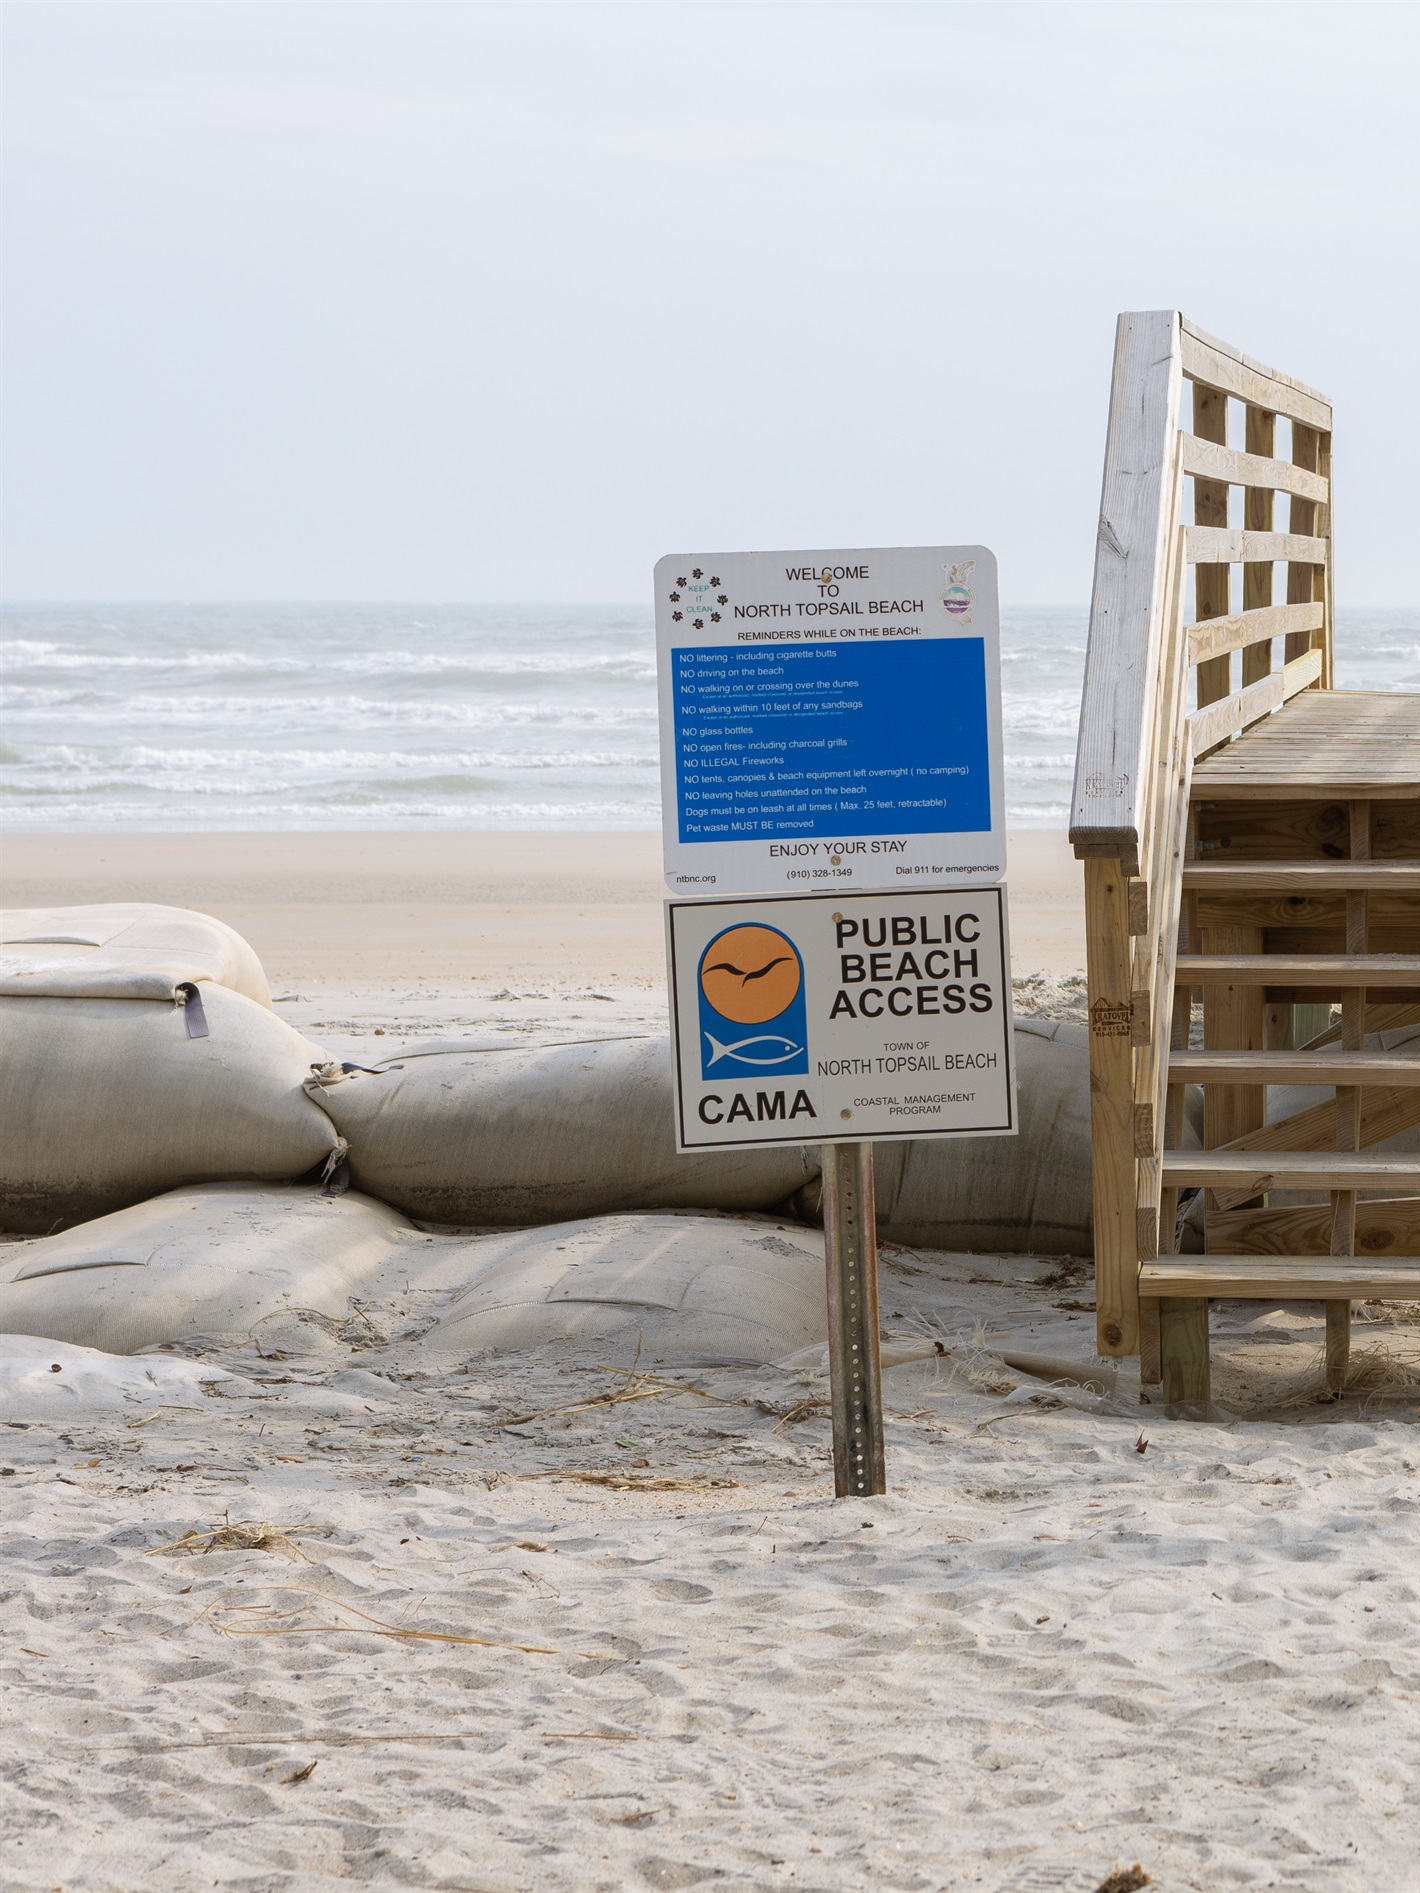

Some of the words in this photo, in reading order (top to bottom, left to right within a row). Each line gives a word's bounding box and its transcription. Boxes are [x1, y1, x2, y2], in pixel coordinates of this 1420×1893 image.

[785, 565, 870, 581] WELCOME
[816, 584, 839, 597] TO
[734, 603, 790, 618] NORTH
[795, 601, 864, 616] TOPSAIL
[868, 599, 923, 614] BEACH
[737, 630, 801, 640] REMINDERS
[803, 628, 837, 638] WHILE
[839, 628, 855, 637] ON
[858, 627, 879, 636] THE
[882, 626, 921, 636] BEACH:
[679, 653, 694, 662] NO
[696, 654, 728, 663] littering
[735, 651, 774, 661] including
[776, 650, 814, 661] cigarette
[815, 649, 837, 658] butts
[679, 669, 695, 678] NO
[696, 669, 726, 678] driving
[741, 667, 755, 676] the
[757, 666, 784, 675] beach
[680, 684, 695, 693] NO
[697, 684, 730, 694] walking
[756, 682, 793, 691] crossing
[816, 680, 830, 688] the
[832, 679, 859, 688] dunes
[681, 705, 696, 714] NO
[698, 705, 731, 715] walking
[732, 703, 758, 712] within
[761, 702, 772, 711] 10
[773, 702, 790, 711] feet
[792, 701, 801, 710] of
[802, 702, 819, 712] any
[820, 700, 863, 709] sandbags
[682, 727, 697, 736] NO
[699, 727, 722, 737] glass
[724, 726, 753, 734] bottles
[682, 743, 698, 752] NO
[699, 744, 722, 753] open
[748, 740, 786, 750] including
[788, 738, 825, 748] charcoal
[826, 738, 847, 748] grills
[683, 758, 698, 767] NO
[700, 757, 740, 767] ILLEGAL
[742, 756, 784, 765] Fireworks
[684, 791, 700, 800] NO
[701, 791, 733, 800] leaving
[734, 789, 758, 798] holes
[760, 787, 809, 797] unattended
[824, 786, 838, 794] the
[840, 785, 866, 794] beach
[686, 823, 701, 832] Pet
[702, 823, 729, 832] waste
[730, 820, 758, 830] MUST
[760, 820, 773, 829] BE
[776, 819, 814, 828] removed
[769, 843, 819, 857] ENJOY
[822, 841, 866, 855] YOUR
[870, 840, 907, 853] STAY
[786, 869, 810, 880] (910)
[812, 868, 852, 878] 328-1349
[895, 866, 912, 874] Dial
[914, 865, 928, 874] 911
[931, 865, 943, 873] for
[944, 863, 999, 874] emergencies
[676, 874, 716, 884] ntbnc.org
[835, 913, 980, 948] PUBLIC
[840, 948, 978, 983] BEACH
[828, 982, 992, 1019] ACCESS
[882, 1042, 913, 1051] TOWN
[915, 1040, 929, 1050] OF
[817, 1058, 871, 1076] NORTH
[875, 1055, 940, 1073] TOPSAIL
[944, 1052, 996, 1070] BEACH
[698, 1089, 817, 1124] CAMA
[853, 1096, 899, 1107] COASTAL
[904, 1092, 975, 1104] MANAGEMENT
[889, 1104, 940, 1115] PROGRAM
